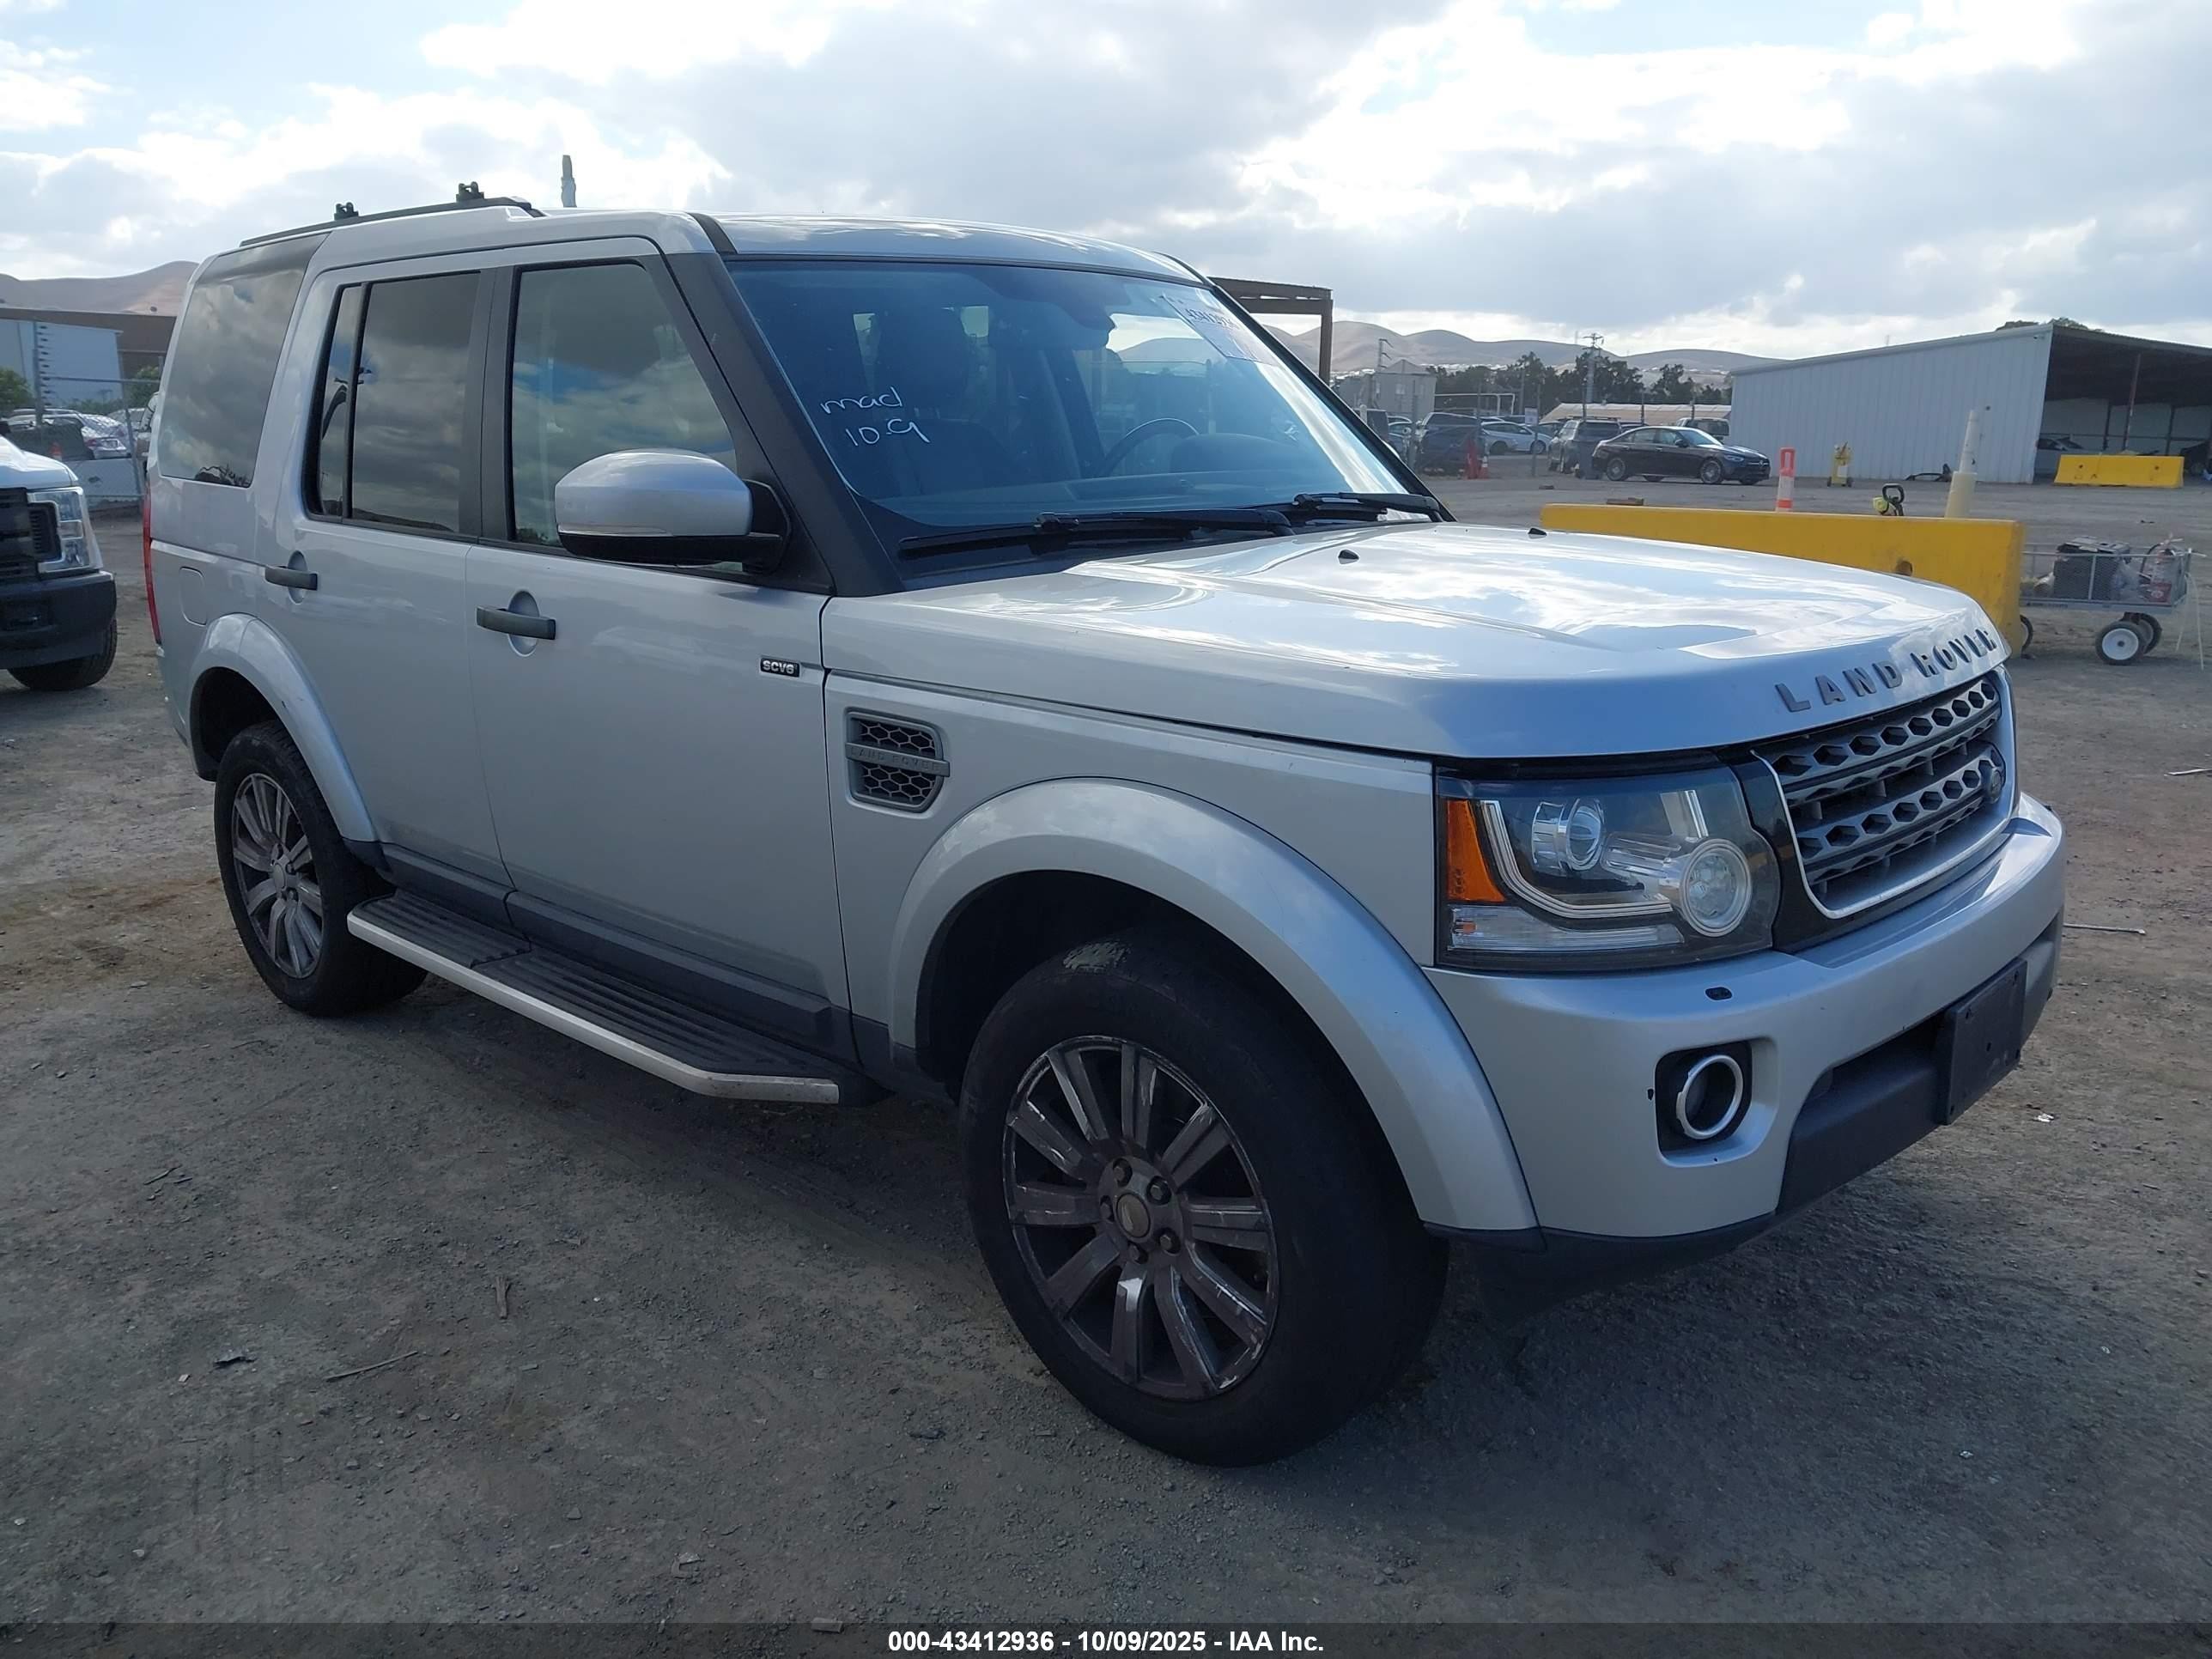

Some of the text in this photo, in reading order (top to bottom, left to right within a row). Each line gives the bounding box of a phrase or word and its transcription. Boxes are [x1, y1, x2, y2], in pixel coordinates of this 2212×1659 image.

[762, 659, 795, 675] SCV6
[1775, 629, 1997, 712] LAND ROVER
